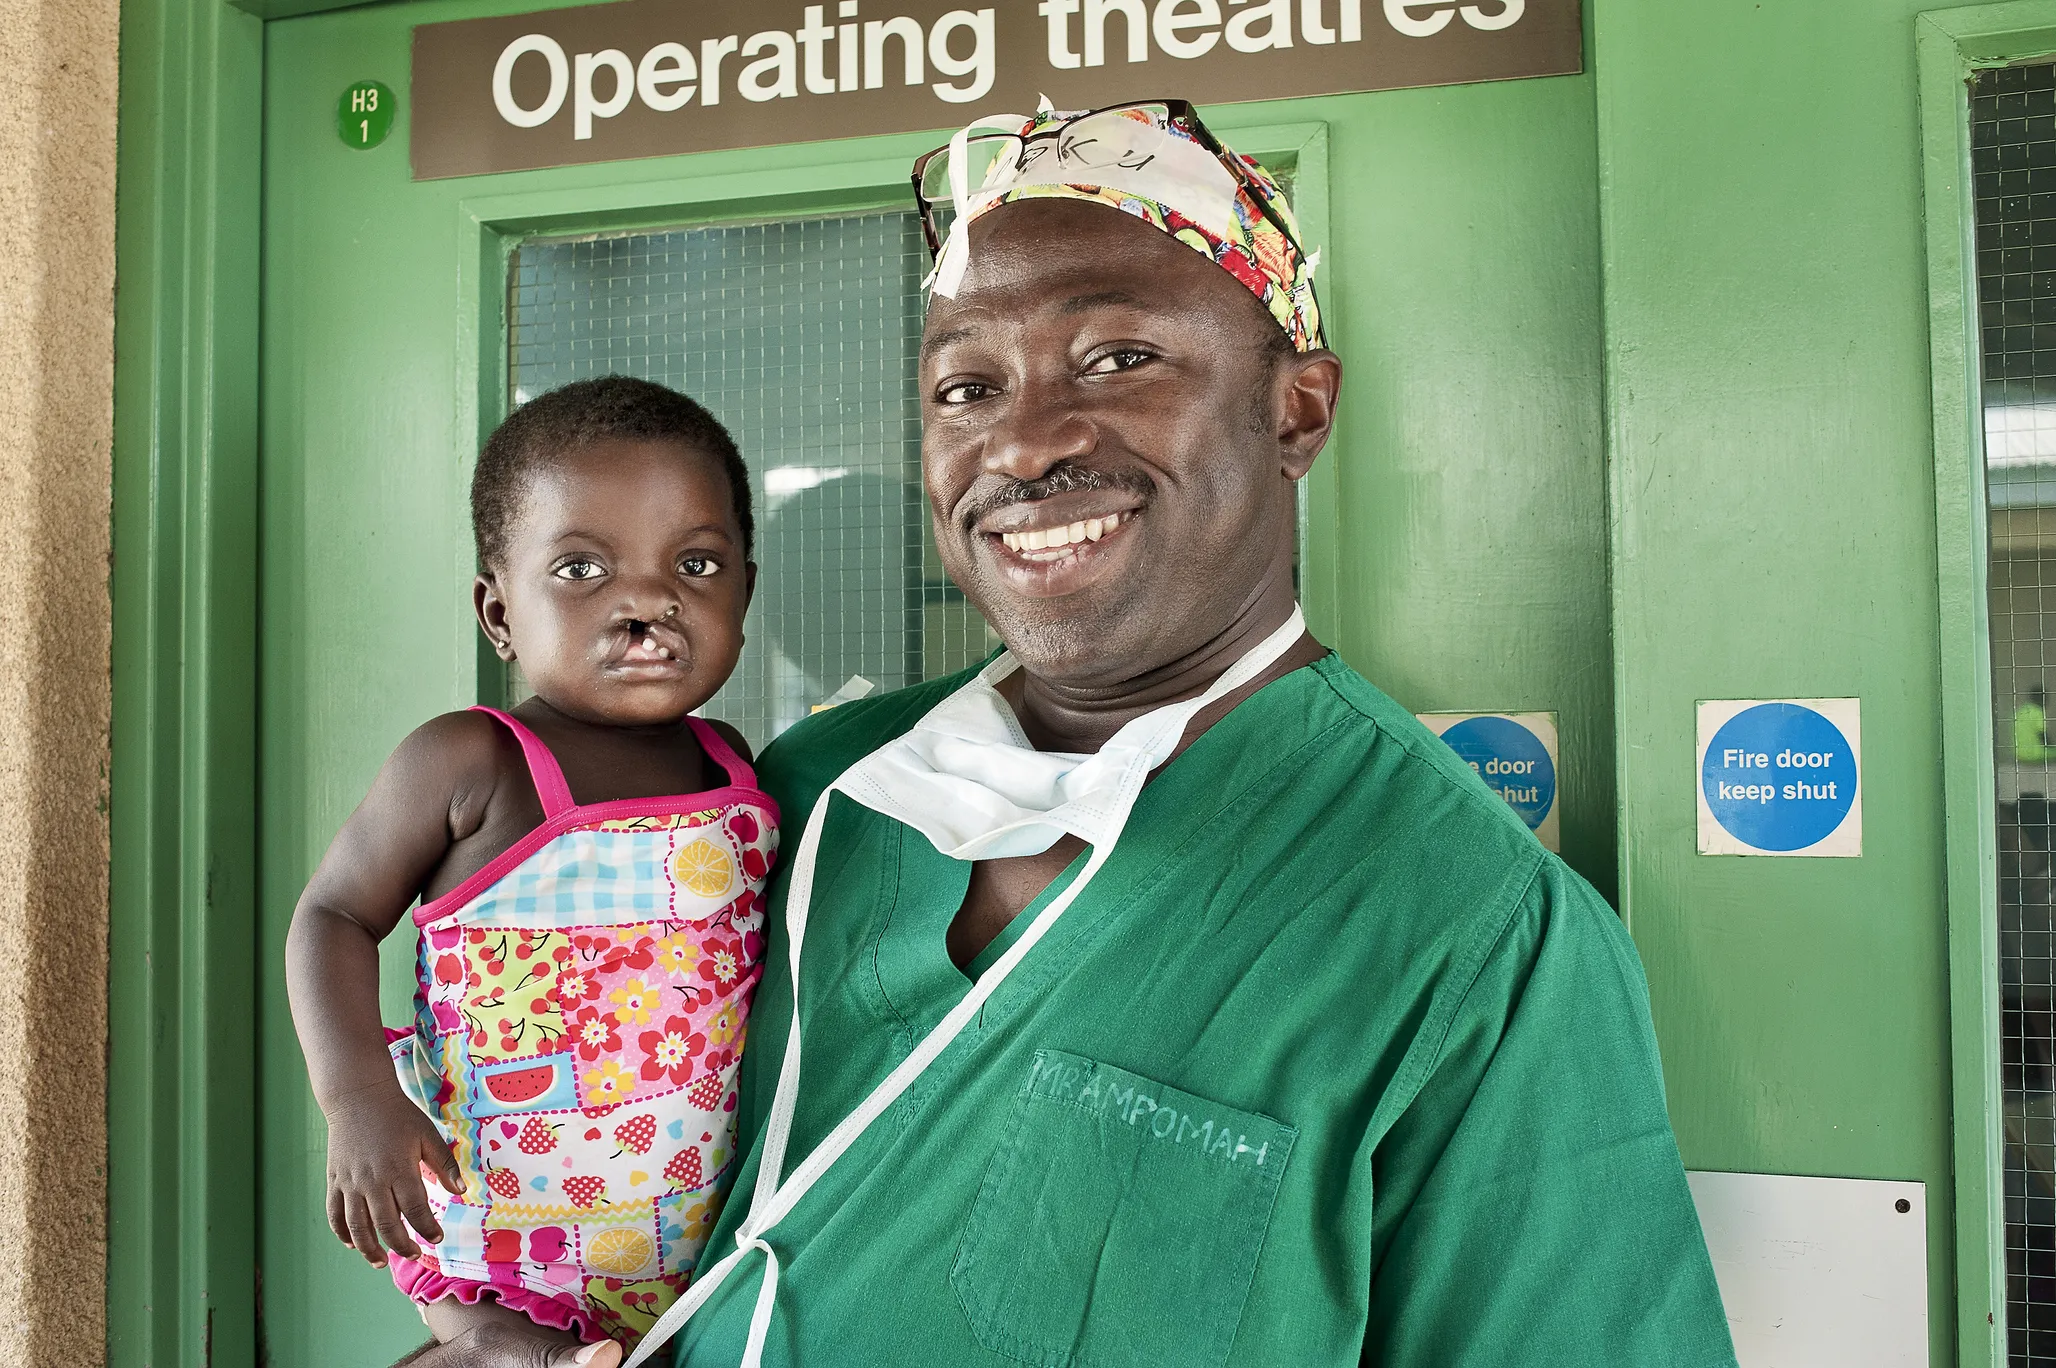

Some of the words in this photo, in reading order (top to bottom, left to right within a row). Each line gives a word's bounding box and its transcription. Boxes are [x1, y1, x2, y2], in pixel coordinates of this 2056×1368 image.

[492, 0, 997, 140] Operating
[352, 88, 378, 112] H3
[360, 119, 368, 143] 1
[1485, 757, 1535, 775] door
[1723, 749, 1769, 769] Fire
[1776, 748, 1833, 769] door
[1719, 781, 1775, 805] keep
[1782, 780, 1837, 800] shut
[1078, 1074, 1269, 1166] AMPOMAH
